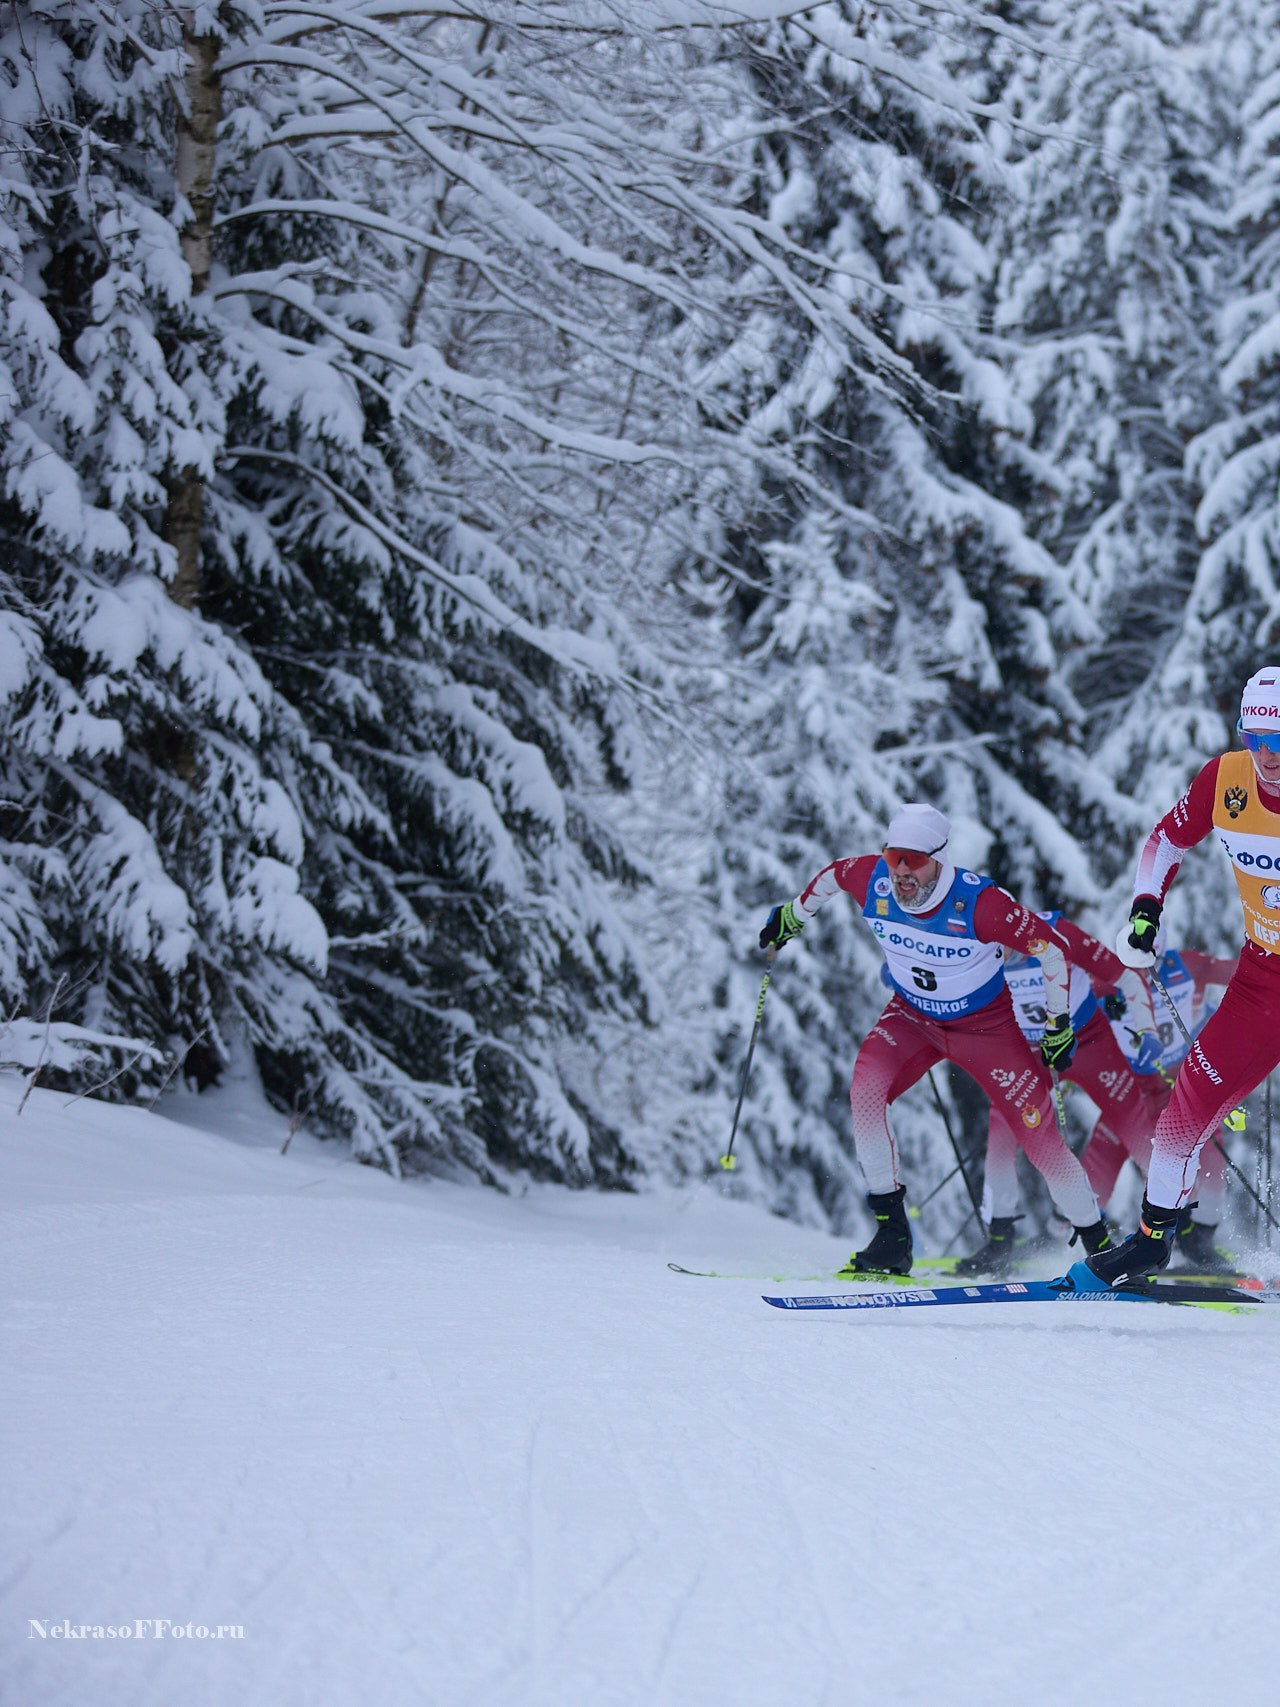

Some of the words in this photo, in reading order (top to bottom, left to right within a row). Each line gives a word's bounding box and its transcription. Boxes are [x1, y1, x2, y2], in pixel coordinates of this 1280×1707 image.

[1014, 906, 1030, 938] ЛУКОЙ
[889, 933, 971, 959] ФОСАГРО
[911, 966, 938, 992] 3
[1009, 976, 1044, 989] ОСАГ
[1020, 1001, 1047, 1024] 5
[1193, 1039, 1223, 1085] ЛУКОЙЛ
[1005, 1069, 1032, 1101] ФОСАГРО
[1014, 1075, 1039, 1108] BIVIUM
[831, 1290, 920, 1307] SALOMON
[1055, 1291, 1119, 1301] SALOMON
